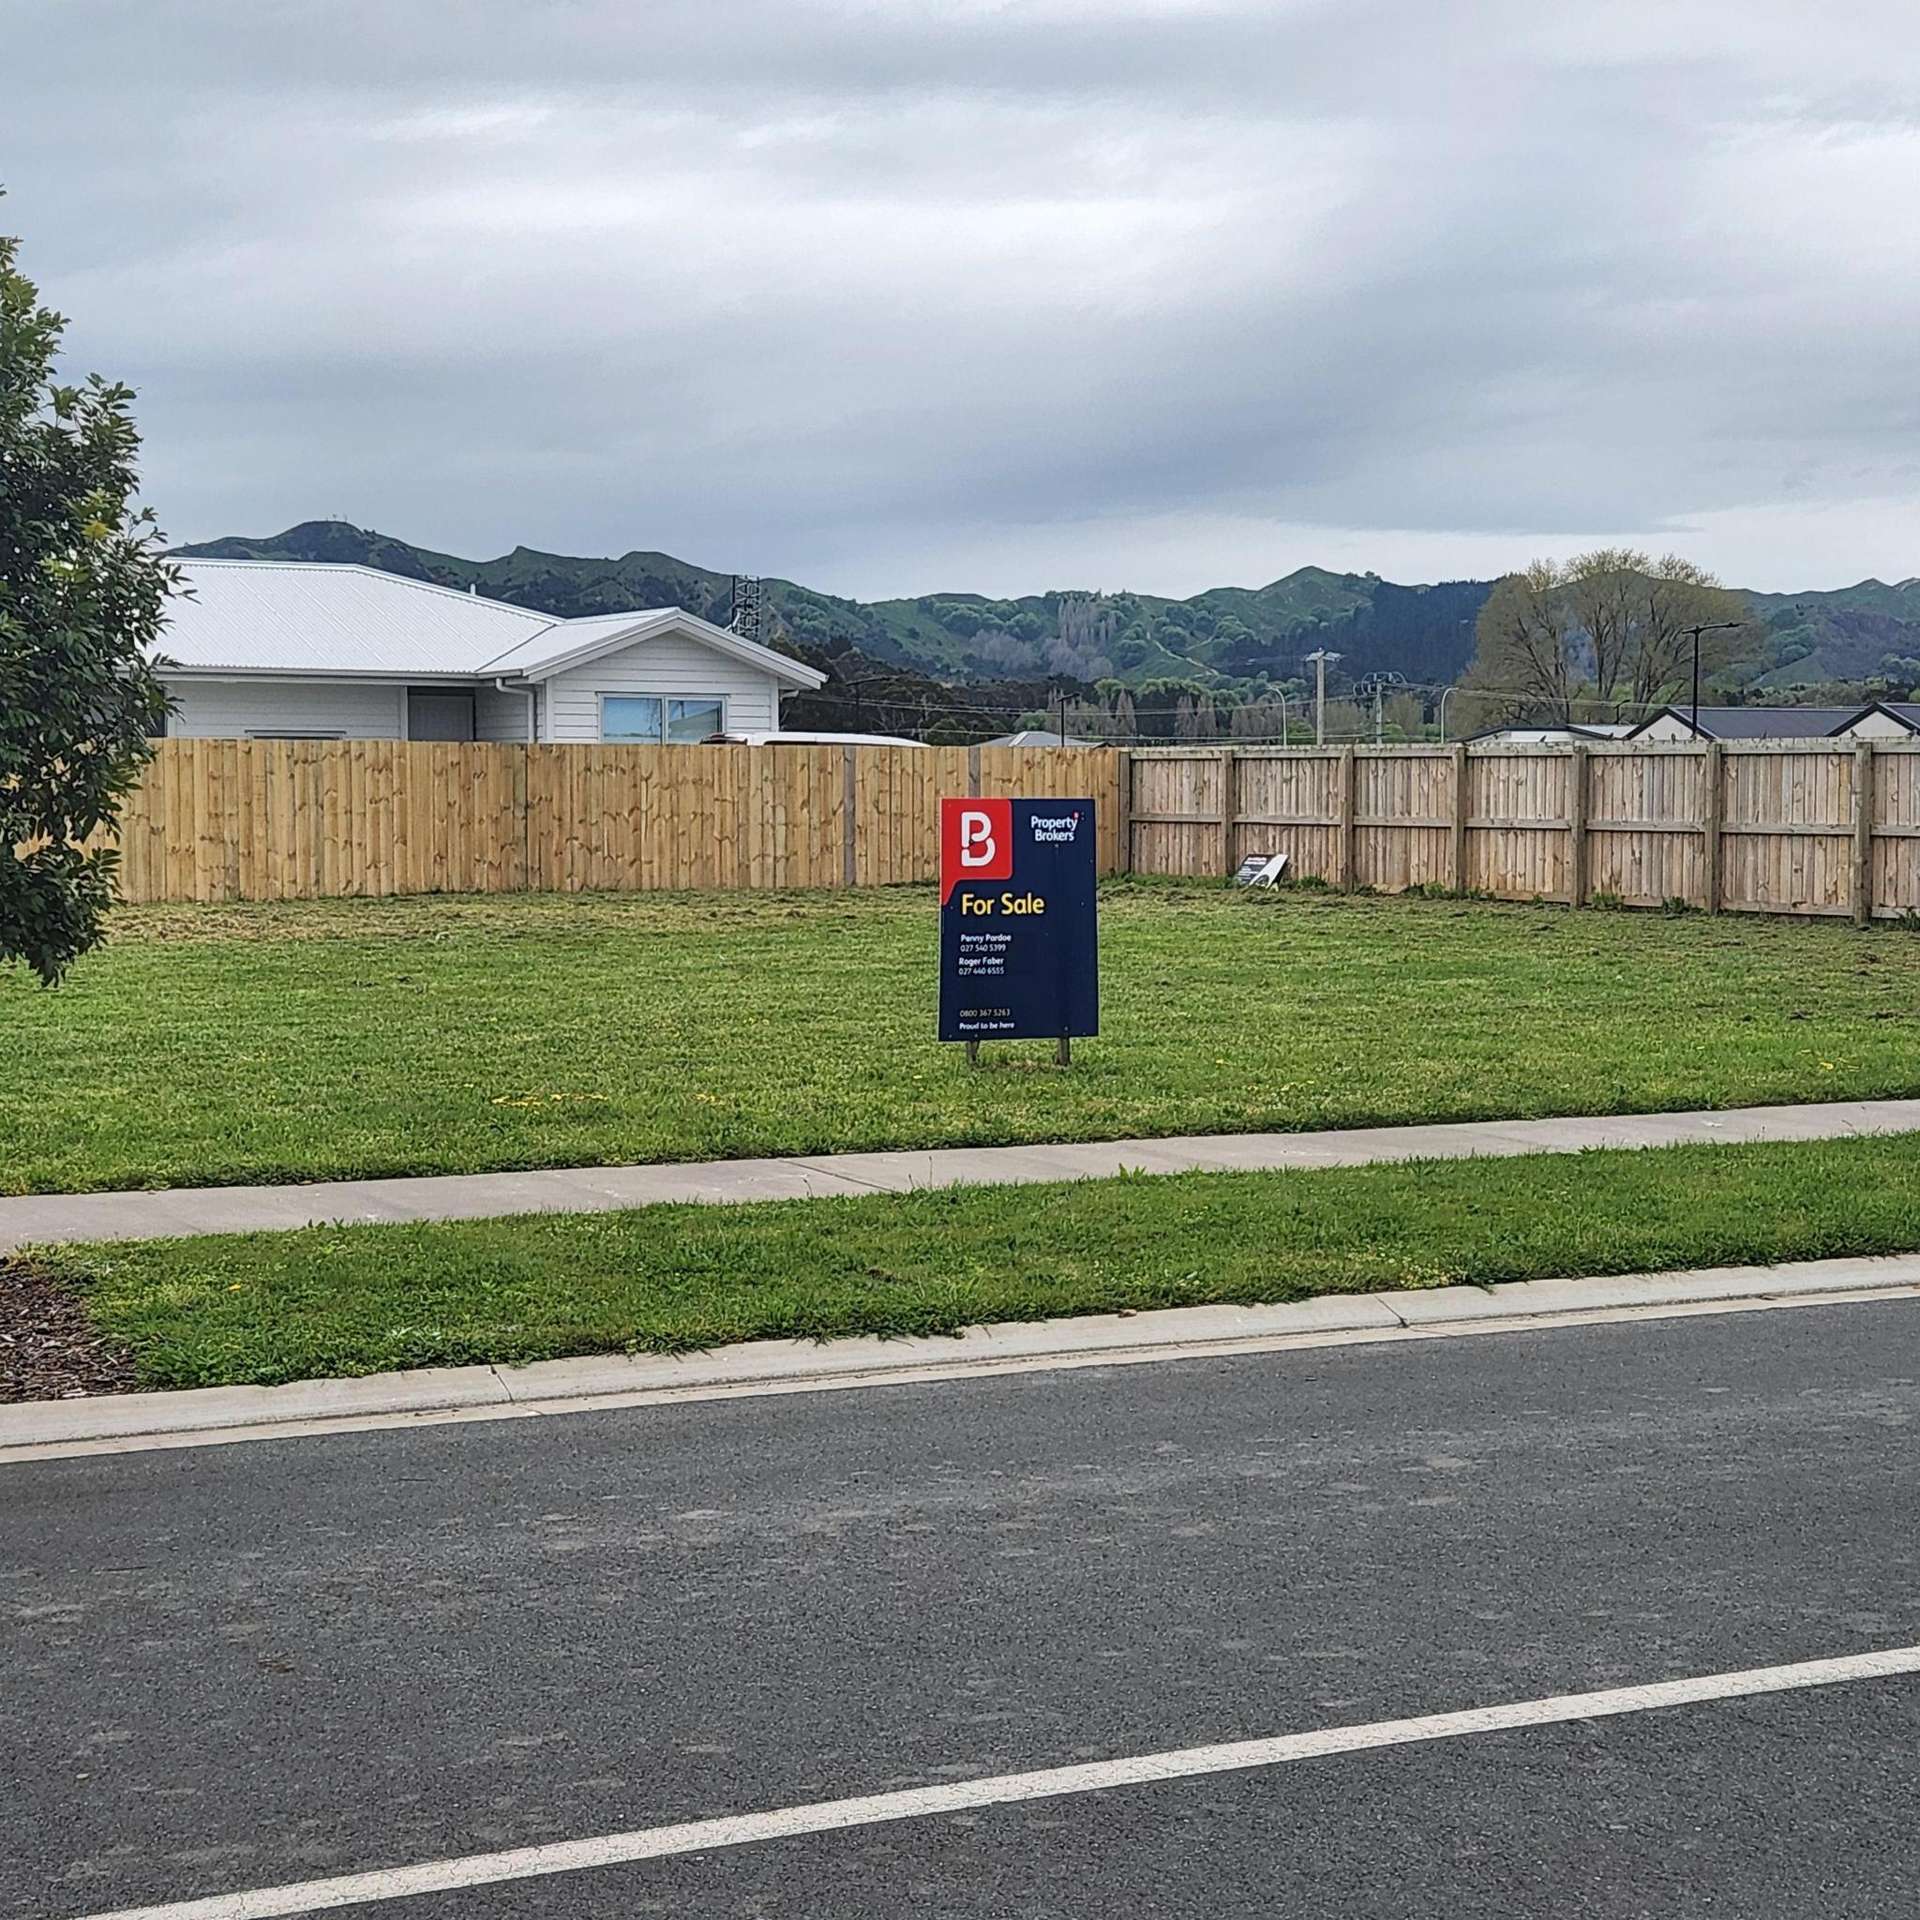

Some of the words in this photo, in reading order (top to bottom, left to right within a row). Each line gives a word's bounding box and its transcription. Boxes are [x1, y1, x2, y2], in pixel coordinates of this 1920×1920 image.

[1031, 812, 1079, 831] Property
[1035, 829, 1074, 841] Brokers
[962, 893, 995, 915] For
[1001, 892, 1045, 914] Sale
[961, 934, 984, 944] Penny
[986, 934, 1011, 942] Pardoe
[960, 944, 973, 952] 027
[959, 957, 981, 967] Roger
[983, 957, 1004, 965] Faber
[960, 1022, 979, 1030] Proud
[1000, 1021, 1014, 1029] here
